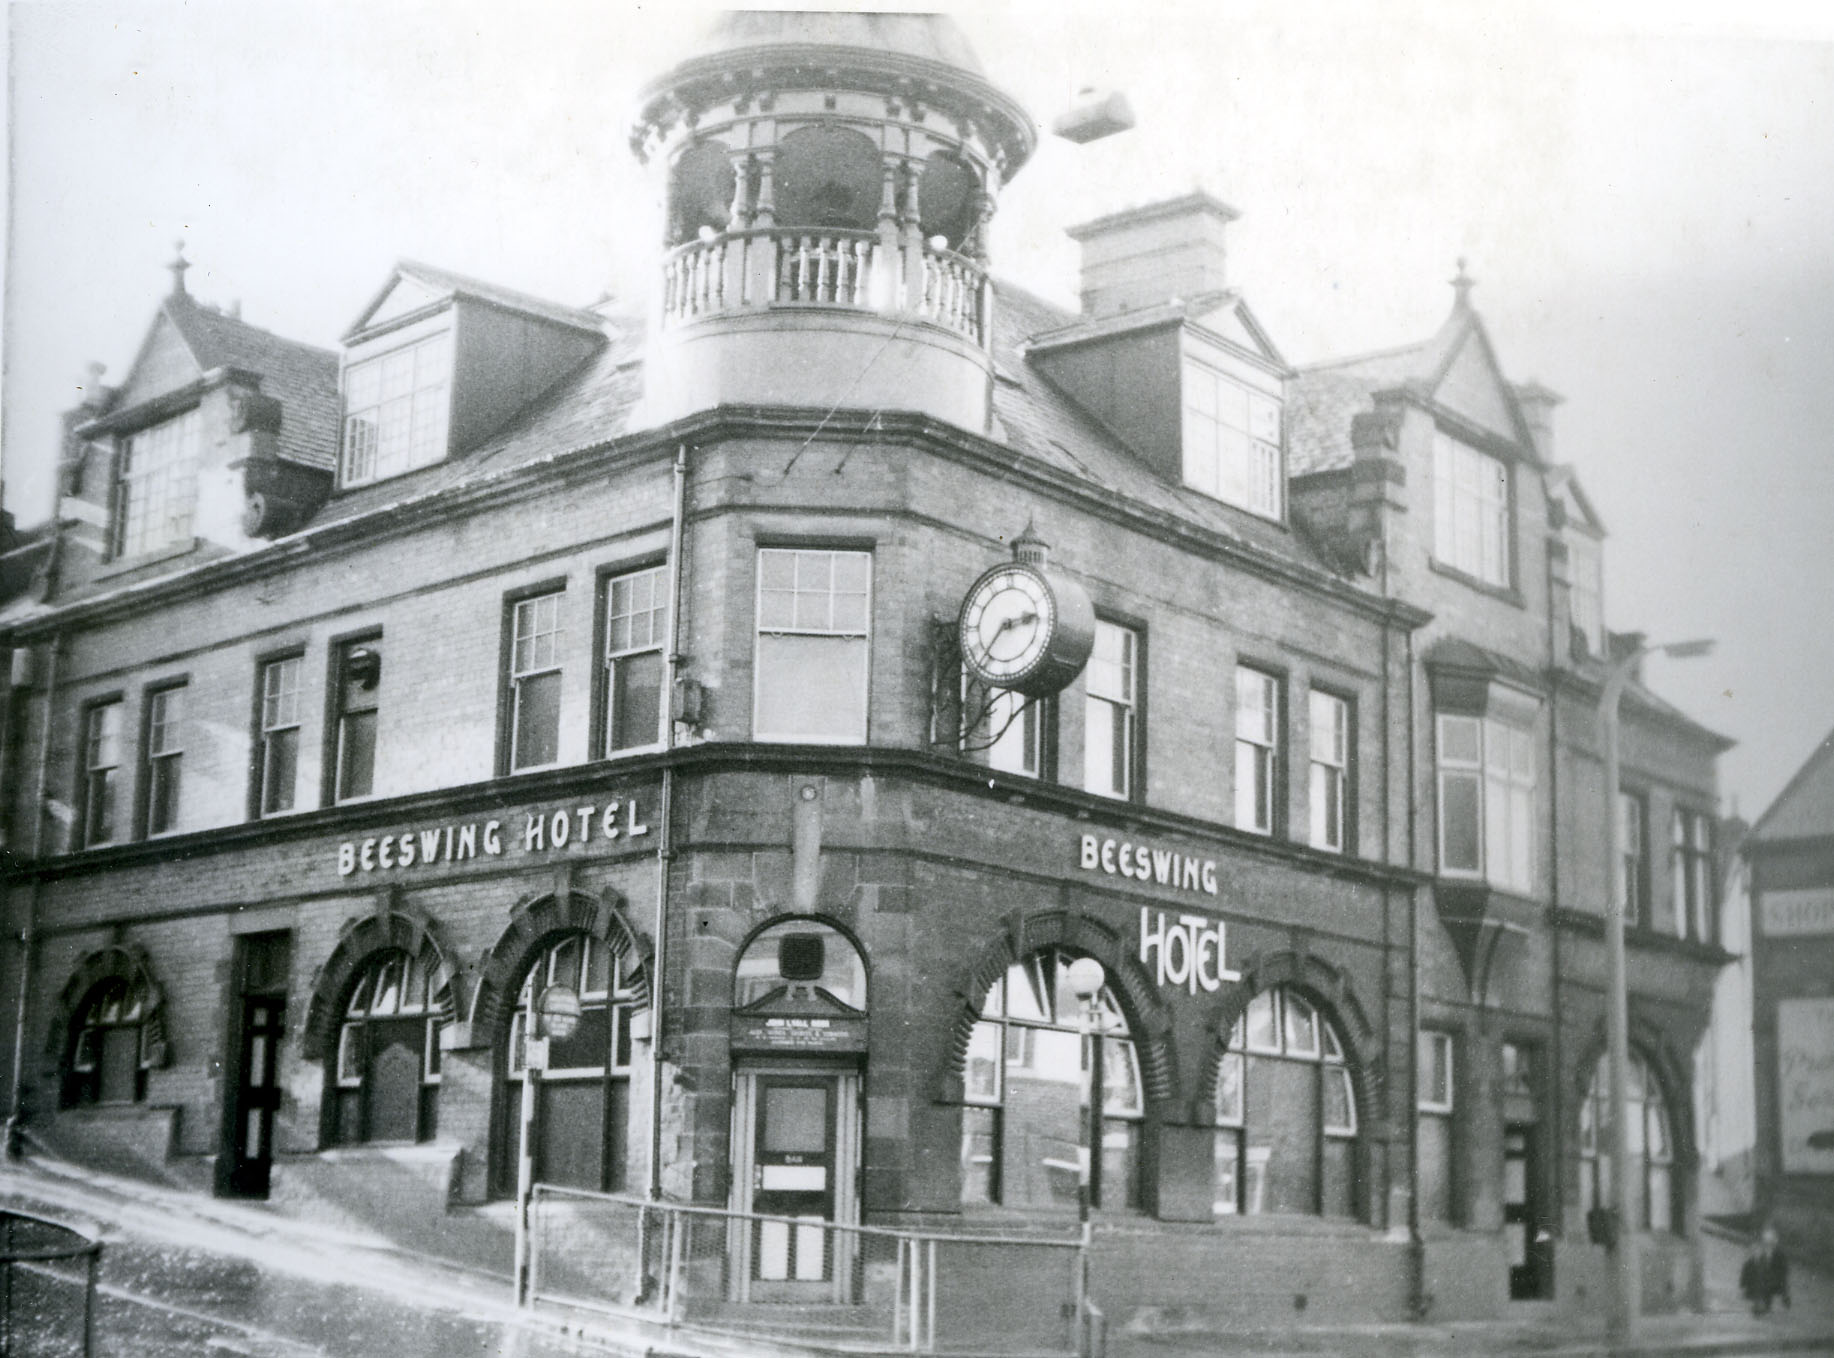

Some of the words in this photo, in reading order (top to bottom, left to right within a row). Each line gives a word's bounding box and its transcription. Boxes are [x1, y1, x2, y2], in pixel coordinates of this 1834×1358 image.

[338, 820, 502, 876] BEESWING
[525, 799, 648, 851] HOTEL
[1081, 834, 1218, 895] BEESWING
[1140, 906, 1242, 996] HOTEL
